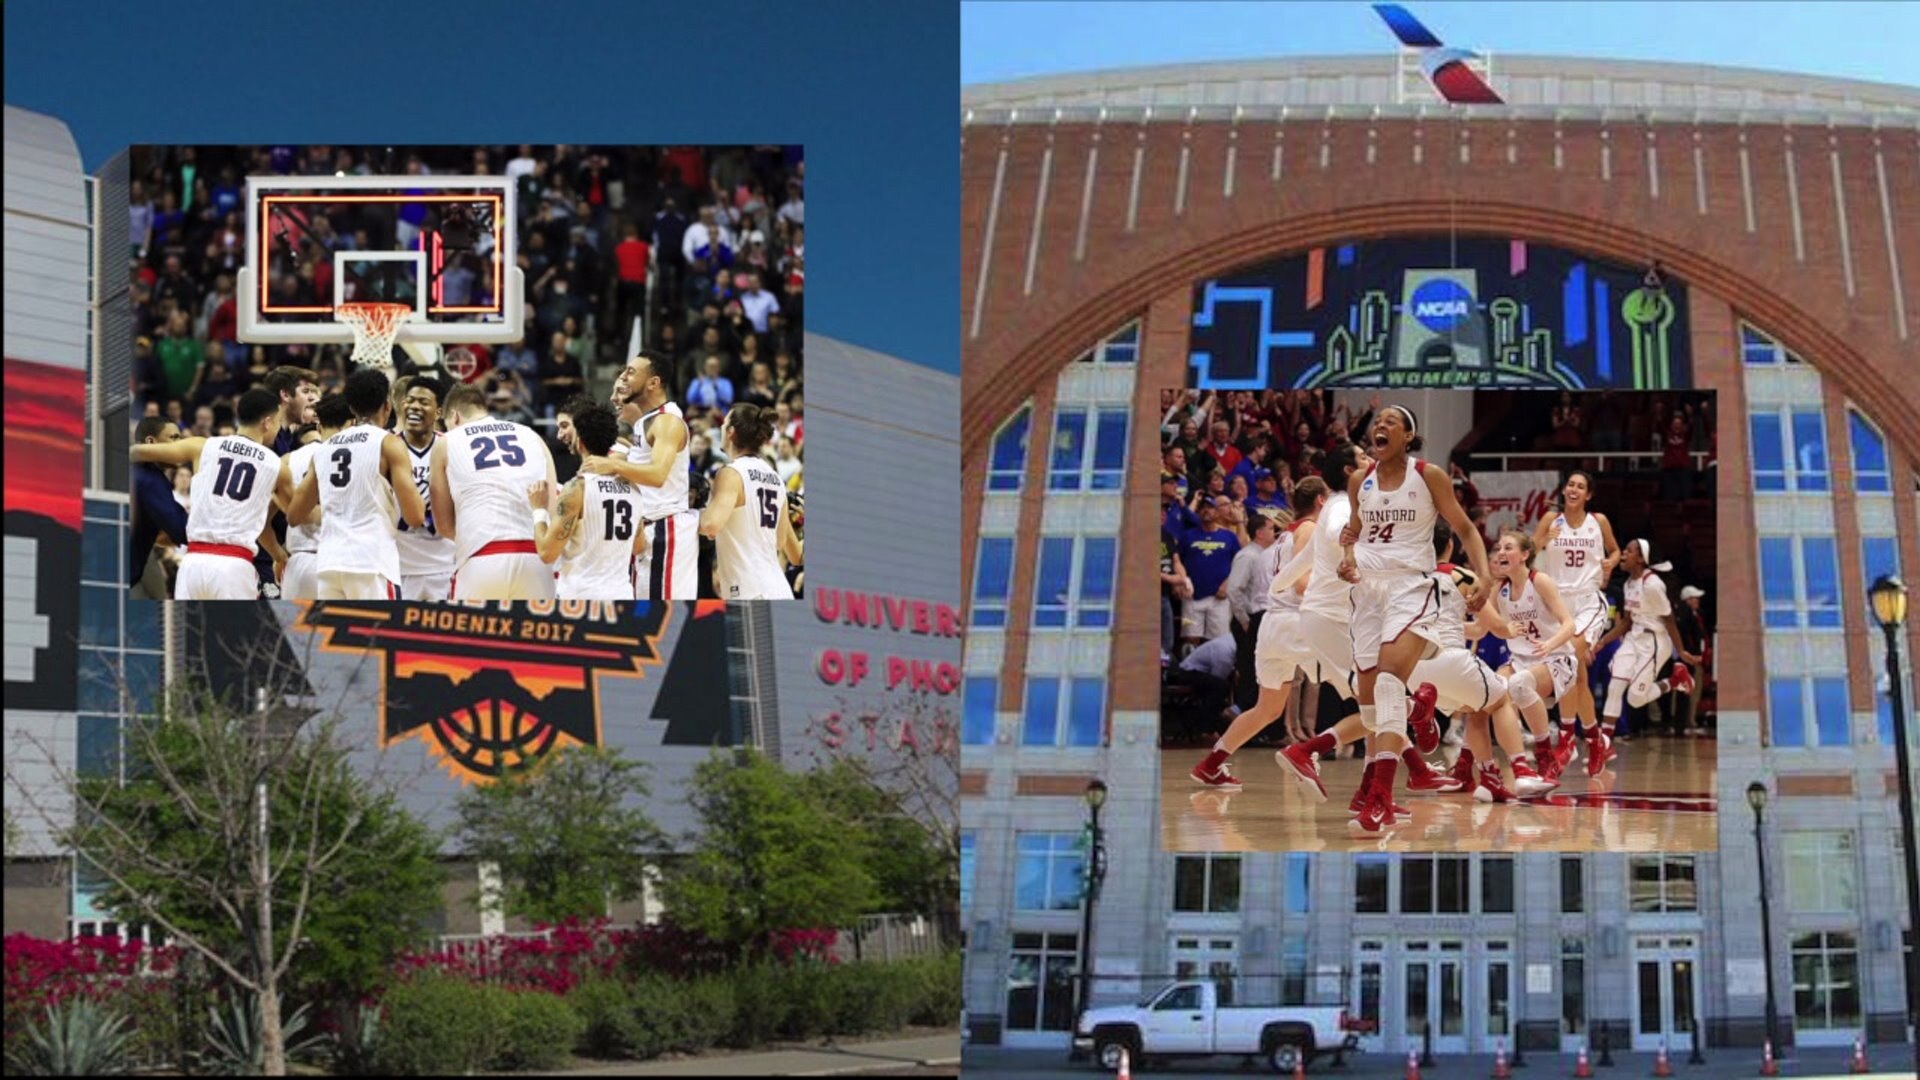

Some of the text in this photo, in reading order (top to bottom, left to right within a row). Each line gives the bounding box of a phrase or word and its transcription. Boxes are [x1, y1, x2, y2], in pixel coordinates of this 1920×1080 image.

[1415, 301, 1468, 317] NCAA
[1386, 371, 1492, 385] WOMEN'S
[464, 422, 516, 436] EDWARDS
[219, 440, 266, 461] ALBERTS
[470, 434, 527, 471] 25
[213, 456, 257, 502] 10
[329, 448, 352, 488] 3
[602, 498, 633, 541] 13
[757, 487, 779, 529] 15
[1367, 523, 1396, 544] 24
[1553, 537, 1595, 548] STANFORD
[1564, 550, 1585, 568] 32
[404, 607, 513, 638] PHOENIX
[520, 621, 576, 643] 2017
[819, 648, 961, 695] OF PHO
